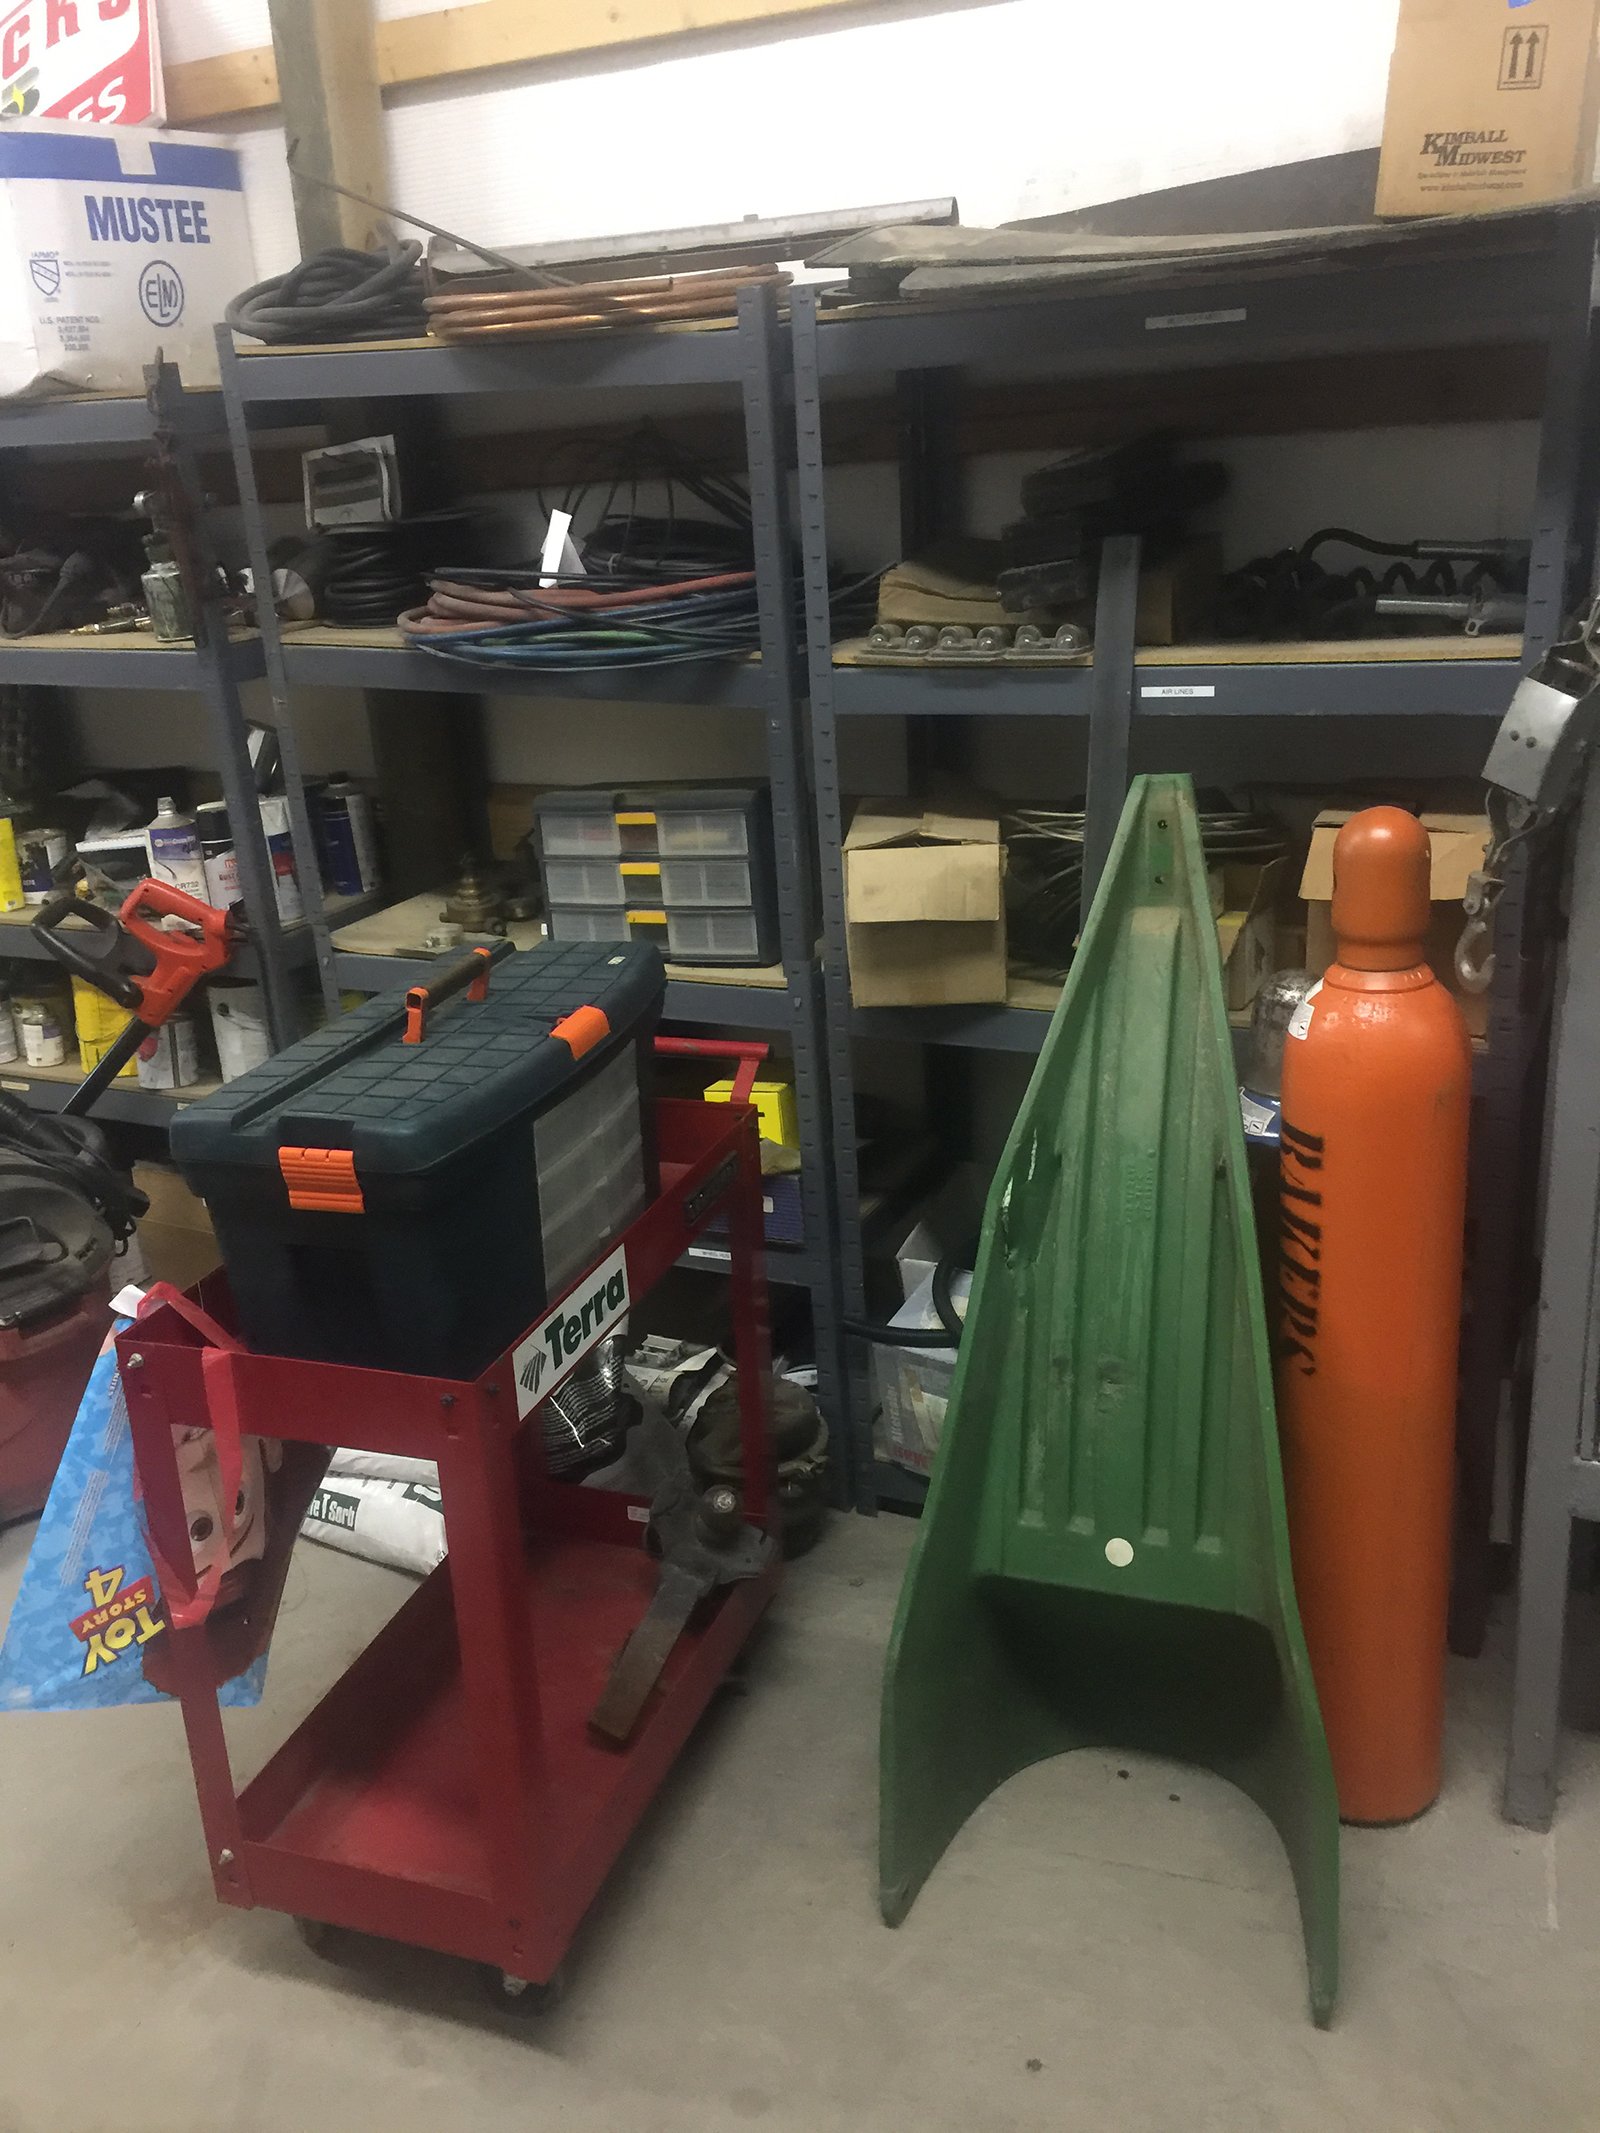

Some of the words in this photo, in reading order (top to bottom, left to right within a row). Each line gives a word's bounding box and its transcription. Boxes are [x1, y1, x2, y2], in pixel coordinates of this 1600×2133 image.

[1420, 130, 1508, 155] KIMBALL
[1434, 145, 1526, 166] MIDWEST
[84, 195, 211, 244] MUSTEE
[56, 316, 84, 324] PATENT
[544, 1269, 625, 1370] Terra
[321, 1493, 331, 1519] T
[328, 1500, 355, 1527] Sorb
[84, 1566, 124, 1608] 4
[82, 1588, 147, 1634] STORY
[83, 1606, 166, 1676] TOY
